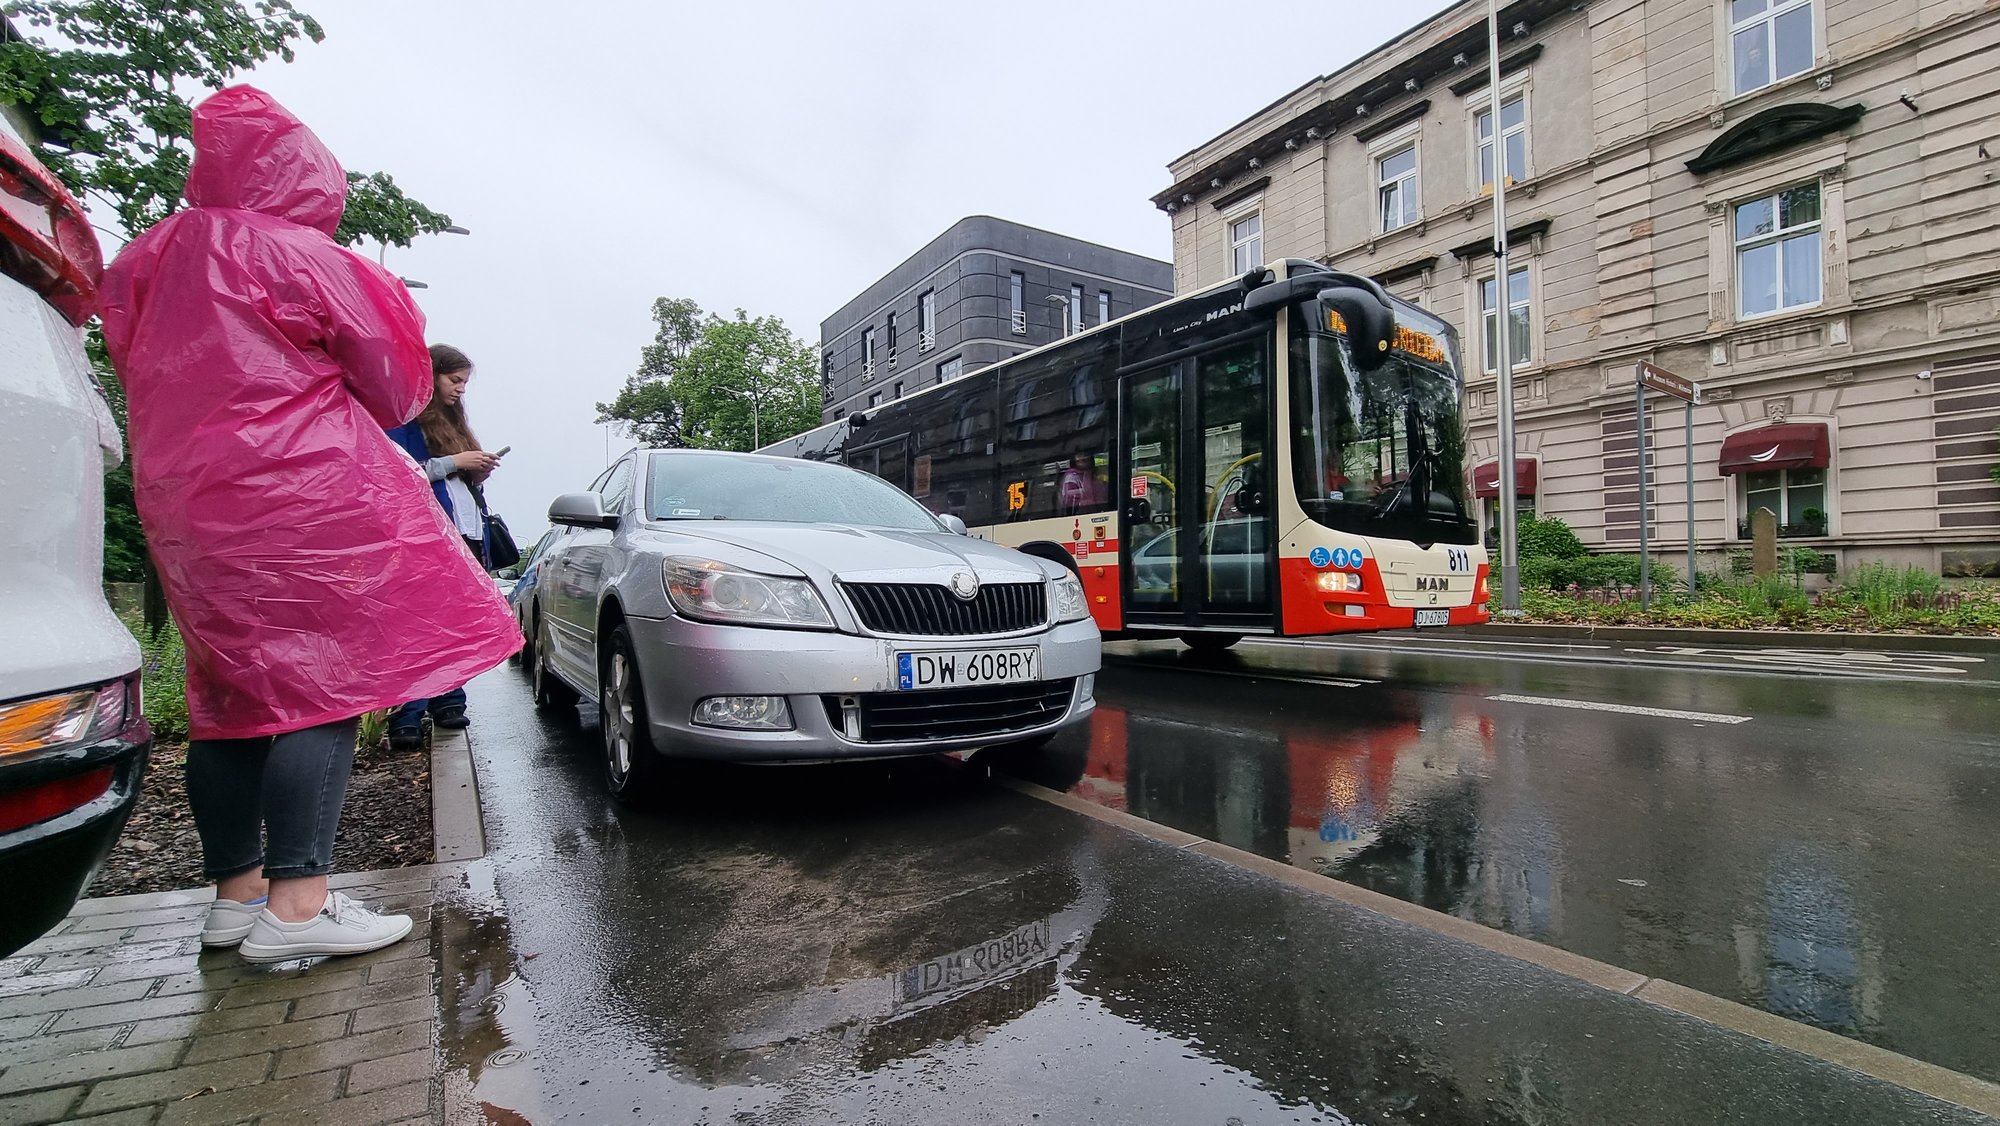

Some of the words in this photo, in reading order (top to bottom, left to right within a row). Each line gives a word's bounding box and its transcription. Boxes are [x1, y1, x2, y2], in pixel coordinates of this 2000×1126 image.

[1206, 303, 1242, 322] MAN
[1007, 482, 1025, 510] 15
[1448, 549, 1469, 571] 811
[1416, 577, 1448, 591] MAN
[1418, 611, 1429, 625] DJ
[1429, 611, 1448, 624] 67805
[917, 655, 956, 685] DW
[966, 652, 1034, 682] 608RY
[900, 675, 911, 684] PL
